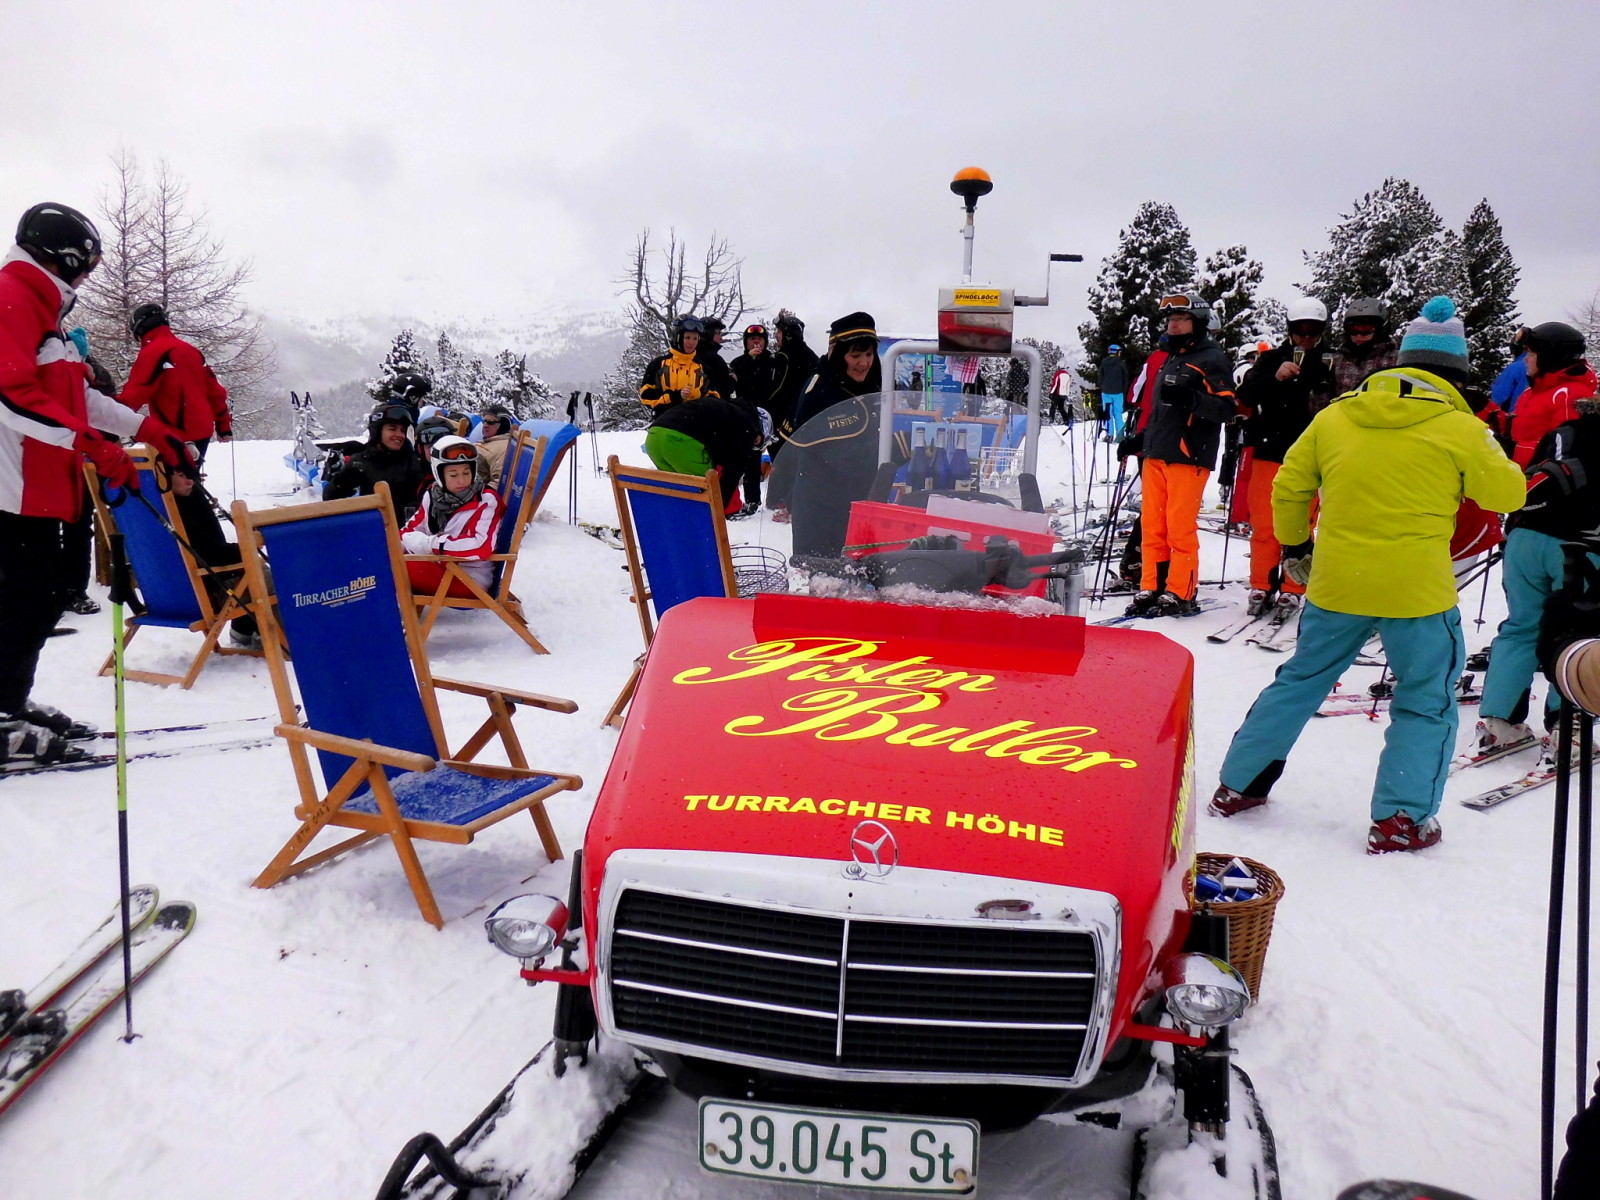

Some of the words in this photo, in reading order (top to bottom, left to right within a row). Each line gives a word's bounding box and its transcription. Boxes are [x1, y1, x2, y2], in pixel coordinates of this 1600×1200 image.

[292, 586, 350, 608] TURRACHER
[349, 576, 376, 591] HÖHE
[673, 637, 997, 692] Pisten
[724, 686, 1138, 773] Butler
[684, 795, 931, 824] TURRACHER
[945, 811, 1064, 847] HÖHE
[719, 1112, 887, 1181] 39.045
[909, 1129, 954, 1183] St
